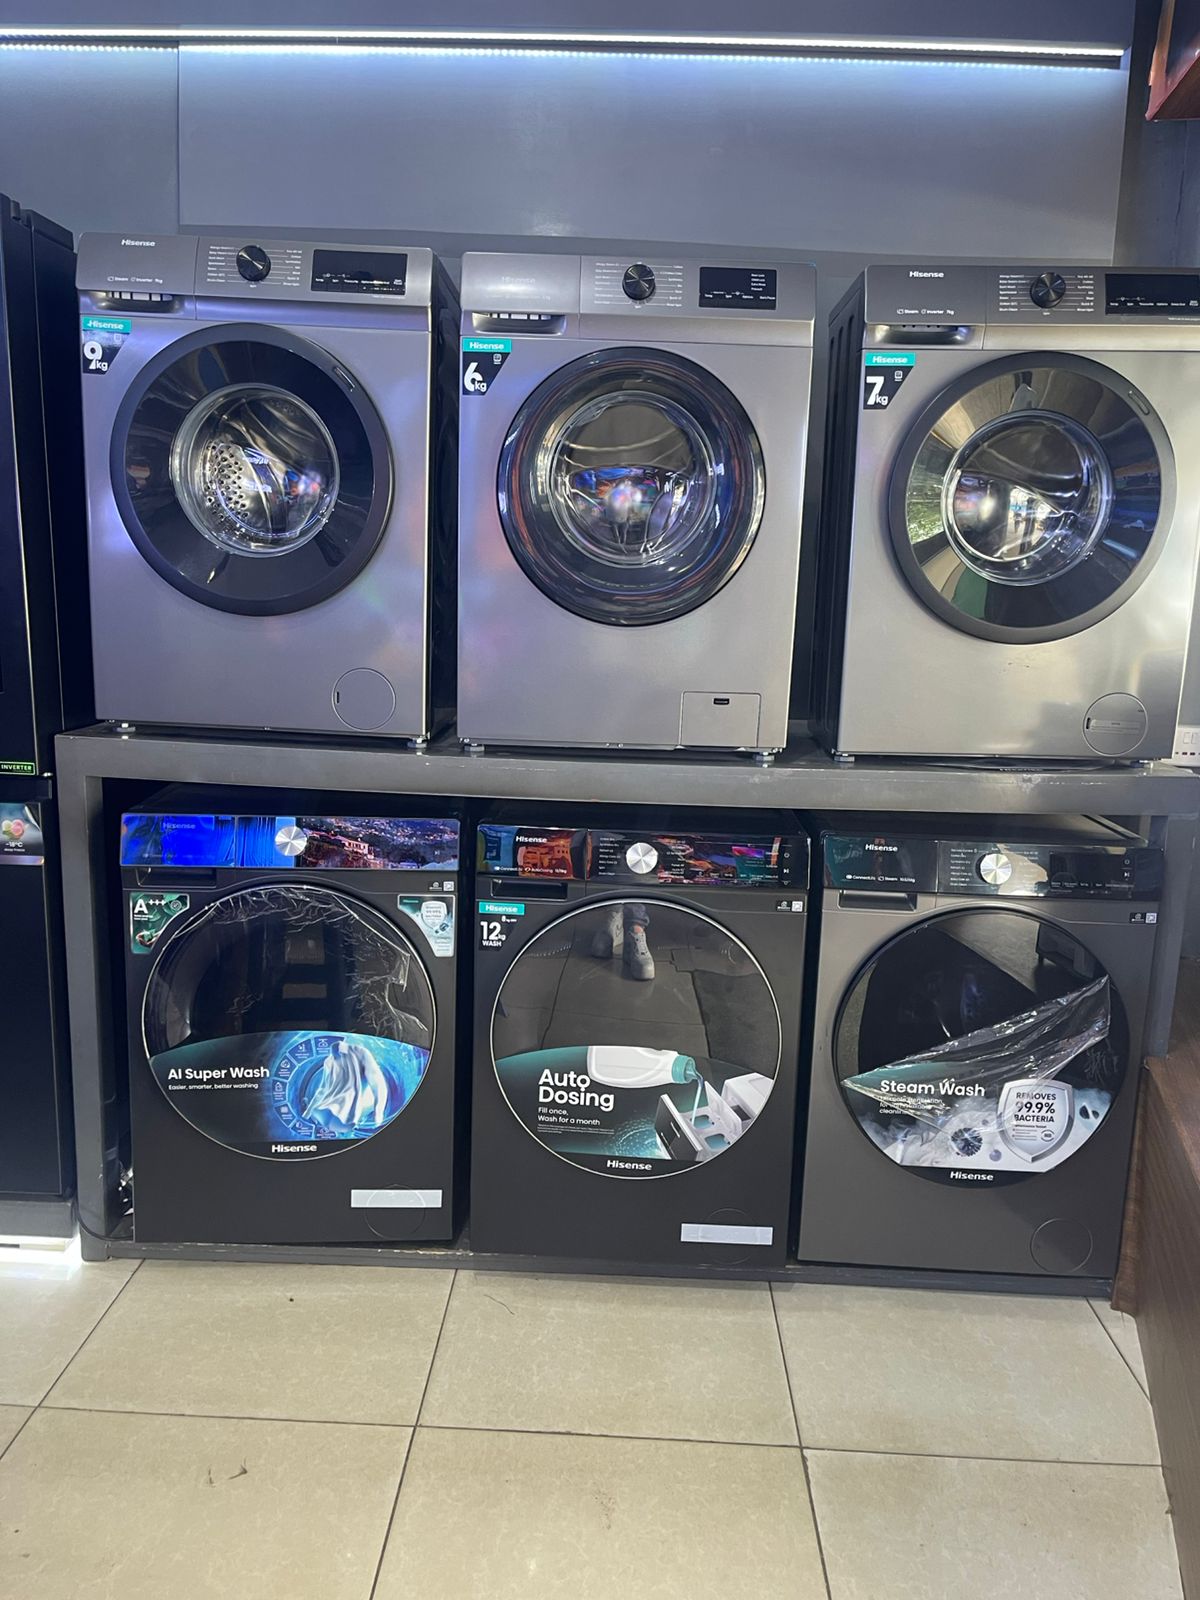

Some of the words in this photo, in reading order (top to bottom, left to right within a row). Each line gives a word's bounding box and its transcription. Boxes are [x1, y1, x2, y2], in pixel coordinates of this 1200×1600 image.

[121, 239, 155, 247] Hisense
[88, 320, 124, 330] Hisense
[469, 341, 505, 350] Hisense
[872, 355, 908, 364] Hisense
[1, 764, 32, 772] INVERTER
[515, 835, 548, 843] Hisense
[865, 844, 898, 852] Hisense
[485, 904, 518, 913] Hisense
[168, 1069, 182, 1079] AI
[185, 1068, 227, 1081] Super
[230, 1067, 270, 1078] Wash
[538, 1069, 591, 1088] Auto
[880, 1080, 935, 1095] Steam
[939, 1082, 985, 1097] Wash
[538, 1086, 615, 1112] Dosing
[1016, 1092, 1056, 1101] REMOVES
[1015, 1101, 1056, 1114] 99.9%
[1014, 1114, 1055, 1122] BACTERIA
[271, 1144, 318, 1153] Hisense
[606, 1160, 652, 1170] Hisense
[950, 1171, 994, 1181] Hisense
